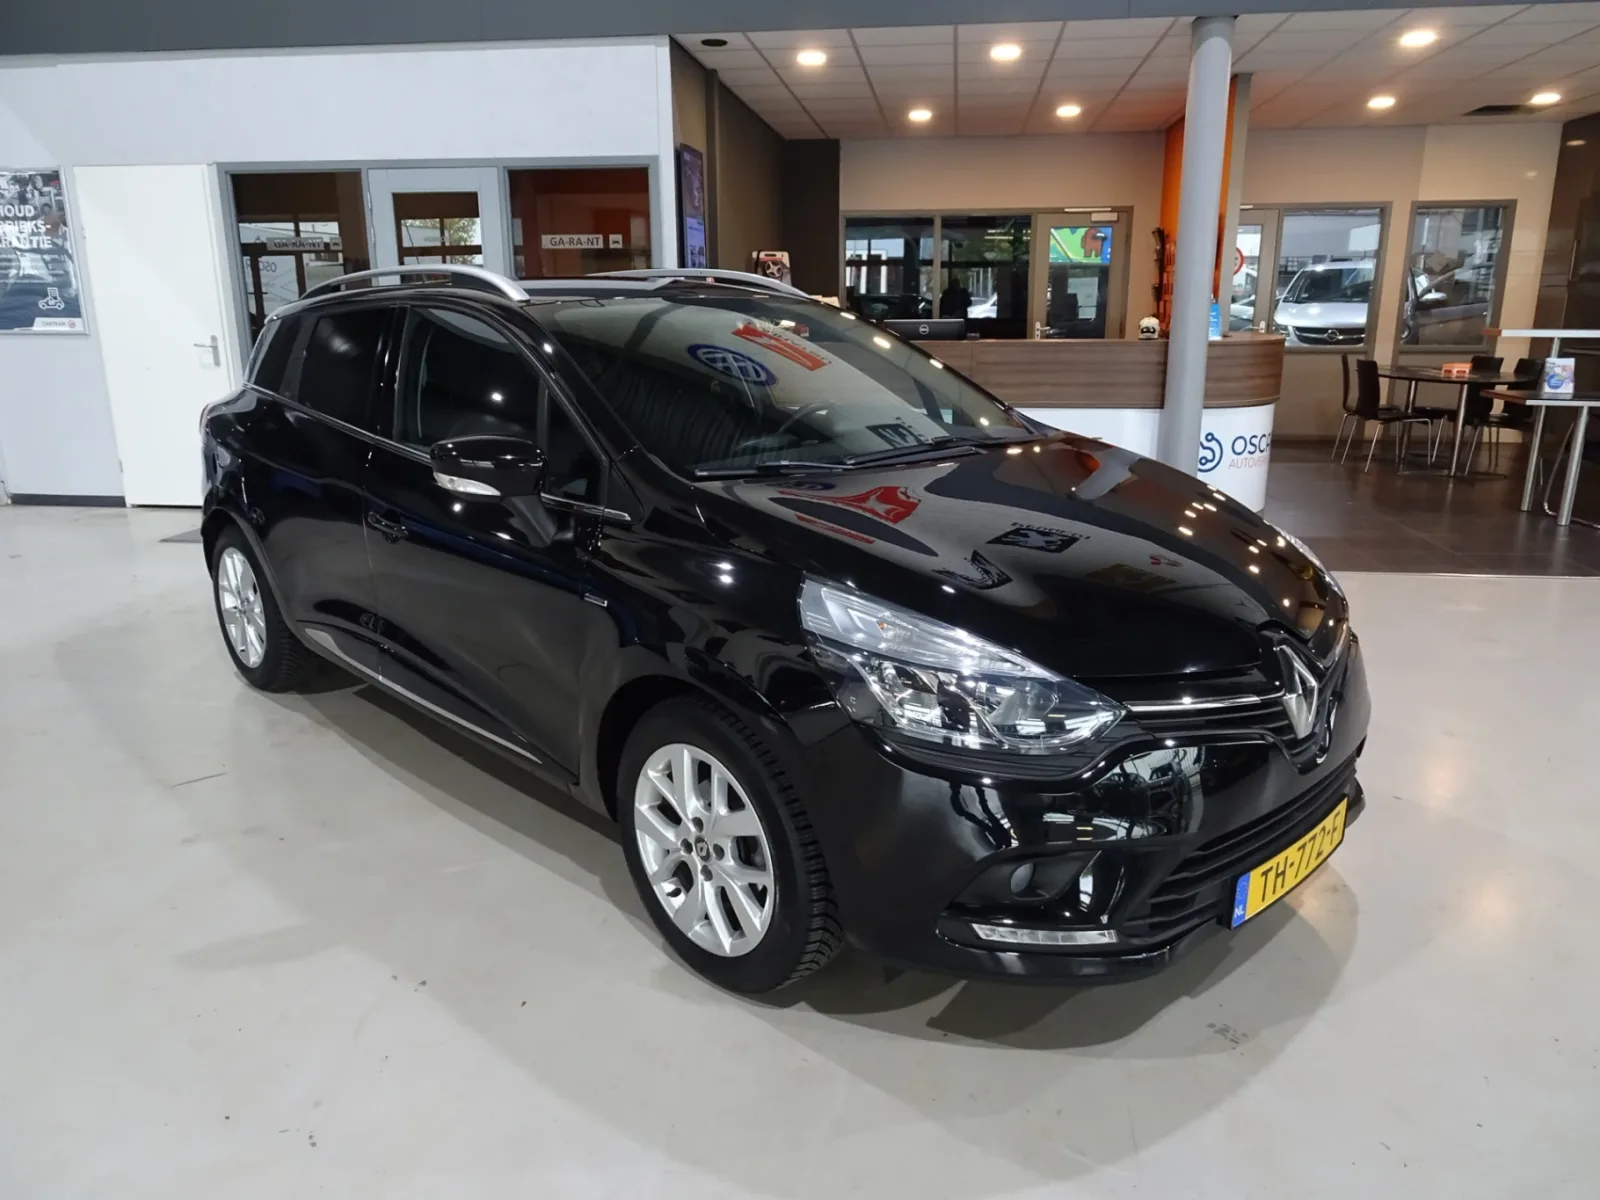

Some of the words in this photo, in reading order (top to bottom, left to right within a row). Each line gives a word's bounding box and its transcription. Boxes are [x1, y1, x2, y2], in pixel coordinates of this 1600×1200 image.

[550, 236, 601, 247] GA-RA-NT
[1260, 811, 1341, 902] TH-772-F
[1233, 905, 1245, 918] NL
